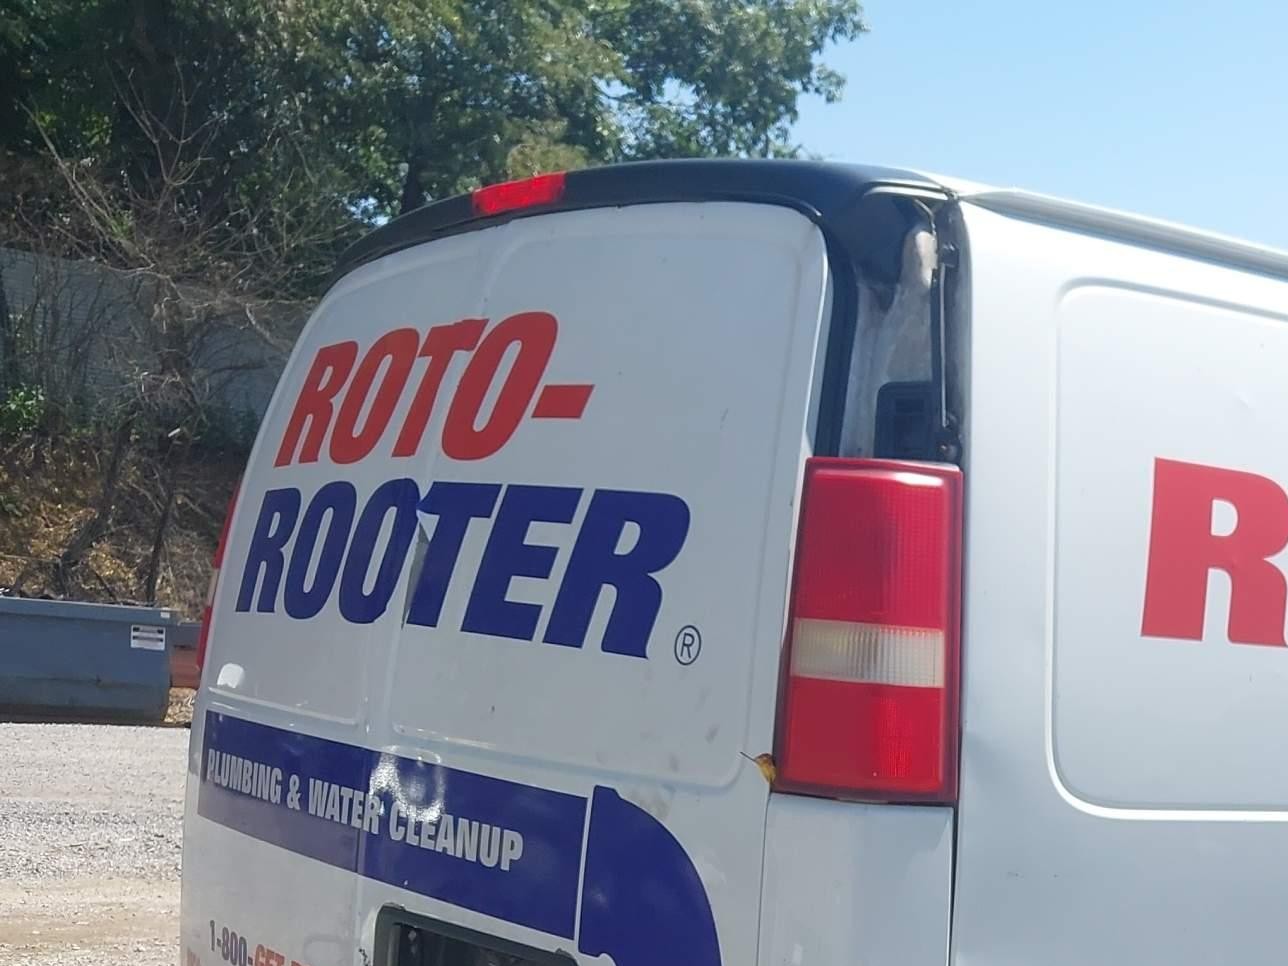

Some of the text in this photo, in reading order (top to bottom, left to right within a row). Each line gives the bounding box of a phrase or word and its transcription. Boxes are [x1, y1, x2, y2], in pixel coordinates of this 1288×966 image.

[273, 311, 595, 467] ROTO-
[235, 478, 690, 659] ROOTER
[207, 748, 523, 881] PLUMBING & WATER CLEANUP
